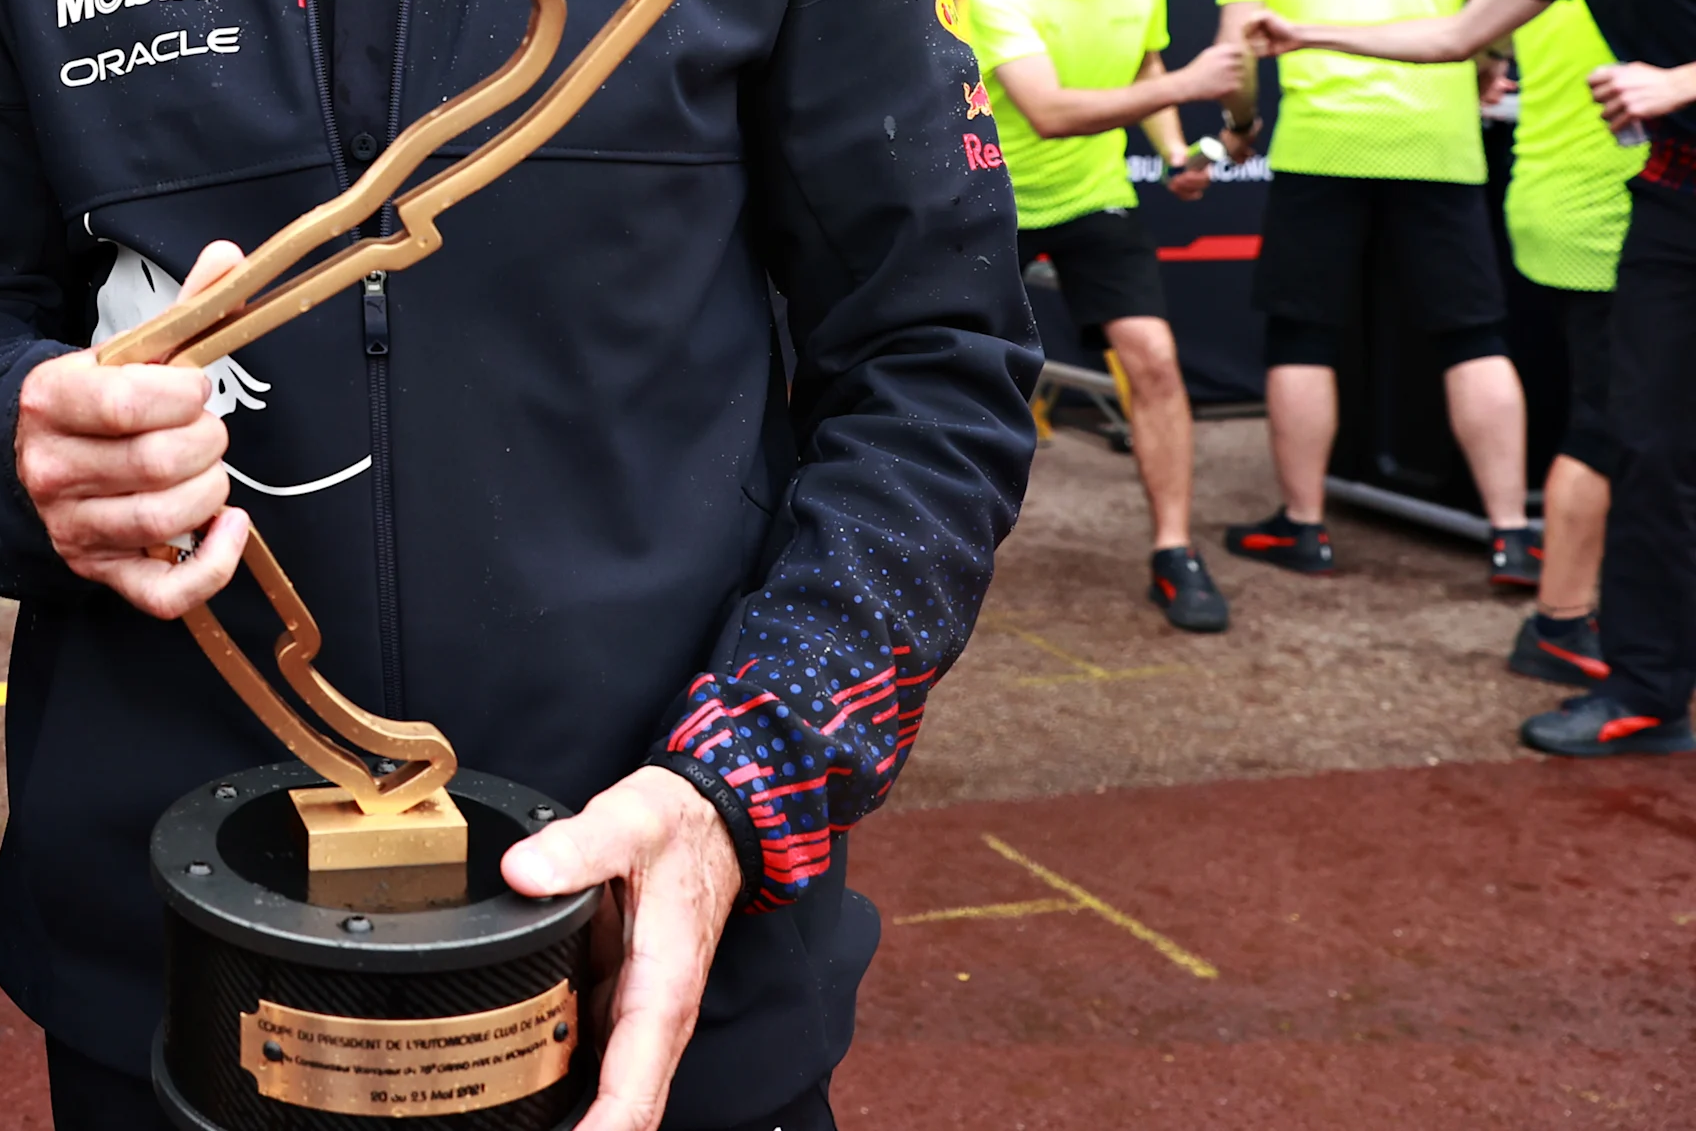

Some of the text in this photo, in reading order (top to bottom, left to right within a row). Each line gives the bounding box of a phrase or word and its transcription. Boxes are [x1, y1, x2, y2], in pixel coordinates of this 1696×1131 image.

[59, 26, 241, 88] ORACLE
[962, 132, 1003, 171] Re
[317, 1032, 382, 1050] PRESIDENT
